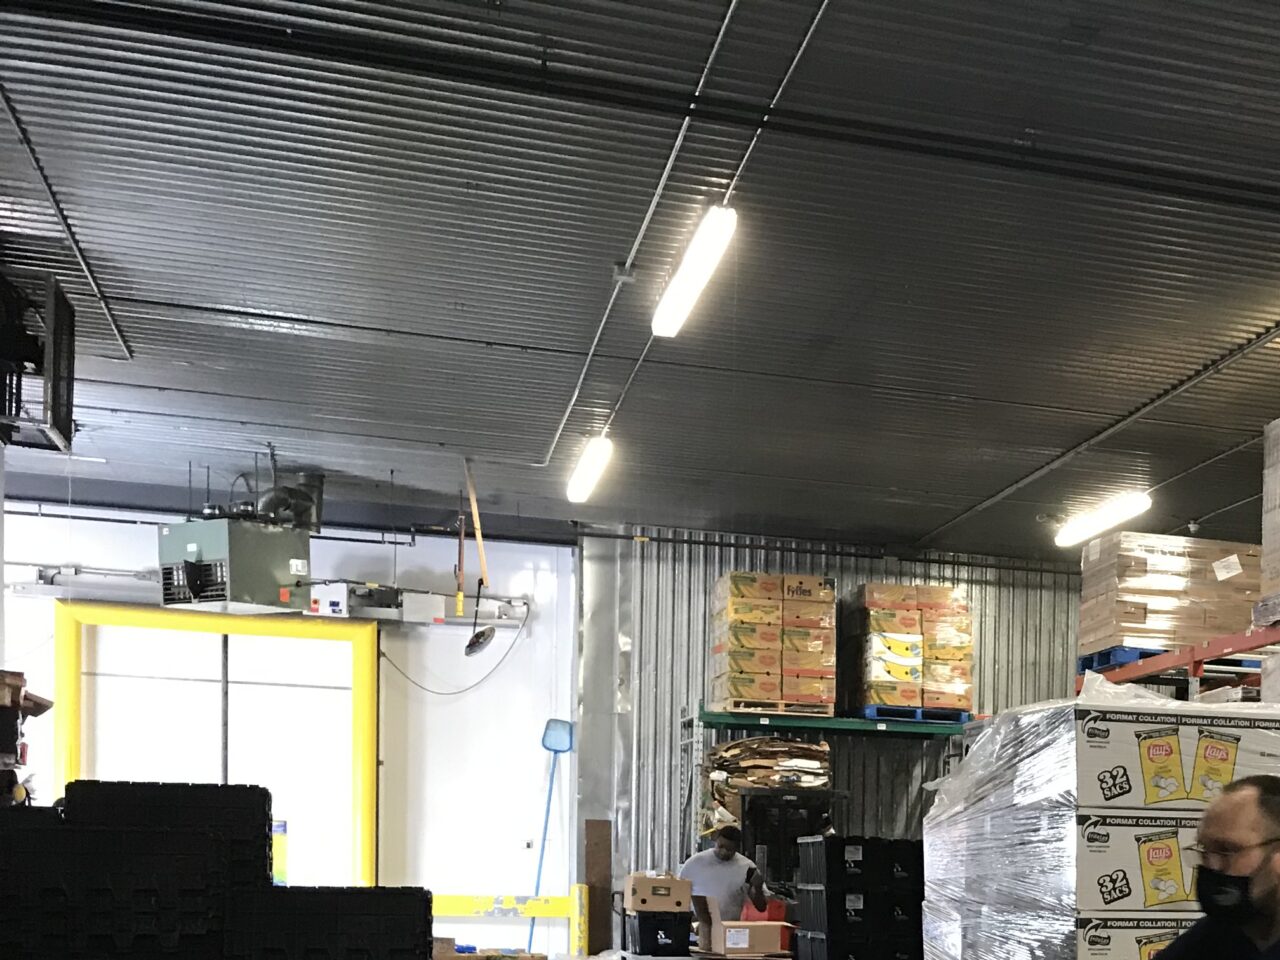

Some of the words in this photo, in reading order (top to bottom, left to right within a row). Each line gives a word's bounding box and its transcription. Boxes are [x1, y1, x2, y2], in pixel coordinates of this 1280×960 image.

[1106, 713, 1137, 721] FORMAT
[1138, 715, 1177, 723] COLLATION
[1182, 717, 1211, 726] FORMAT
[1213, 719, 1249, 727] COLLATION
[1098, 766, 1128, 789] 32
[1102, 780, 1131, 799] SACS
[1106, 818, 1137, 826] FORMAT
[1138, 819, 1176, 827] COLLATION
[1098, 869, 1128, 893] 32
[1102, 884, 1131, 904] SACS
[1107, 920, 1137, 928] FORMAT
[1138, 920, 1177, 928] COLLATION
